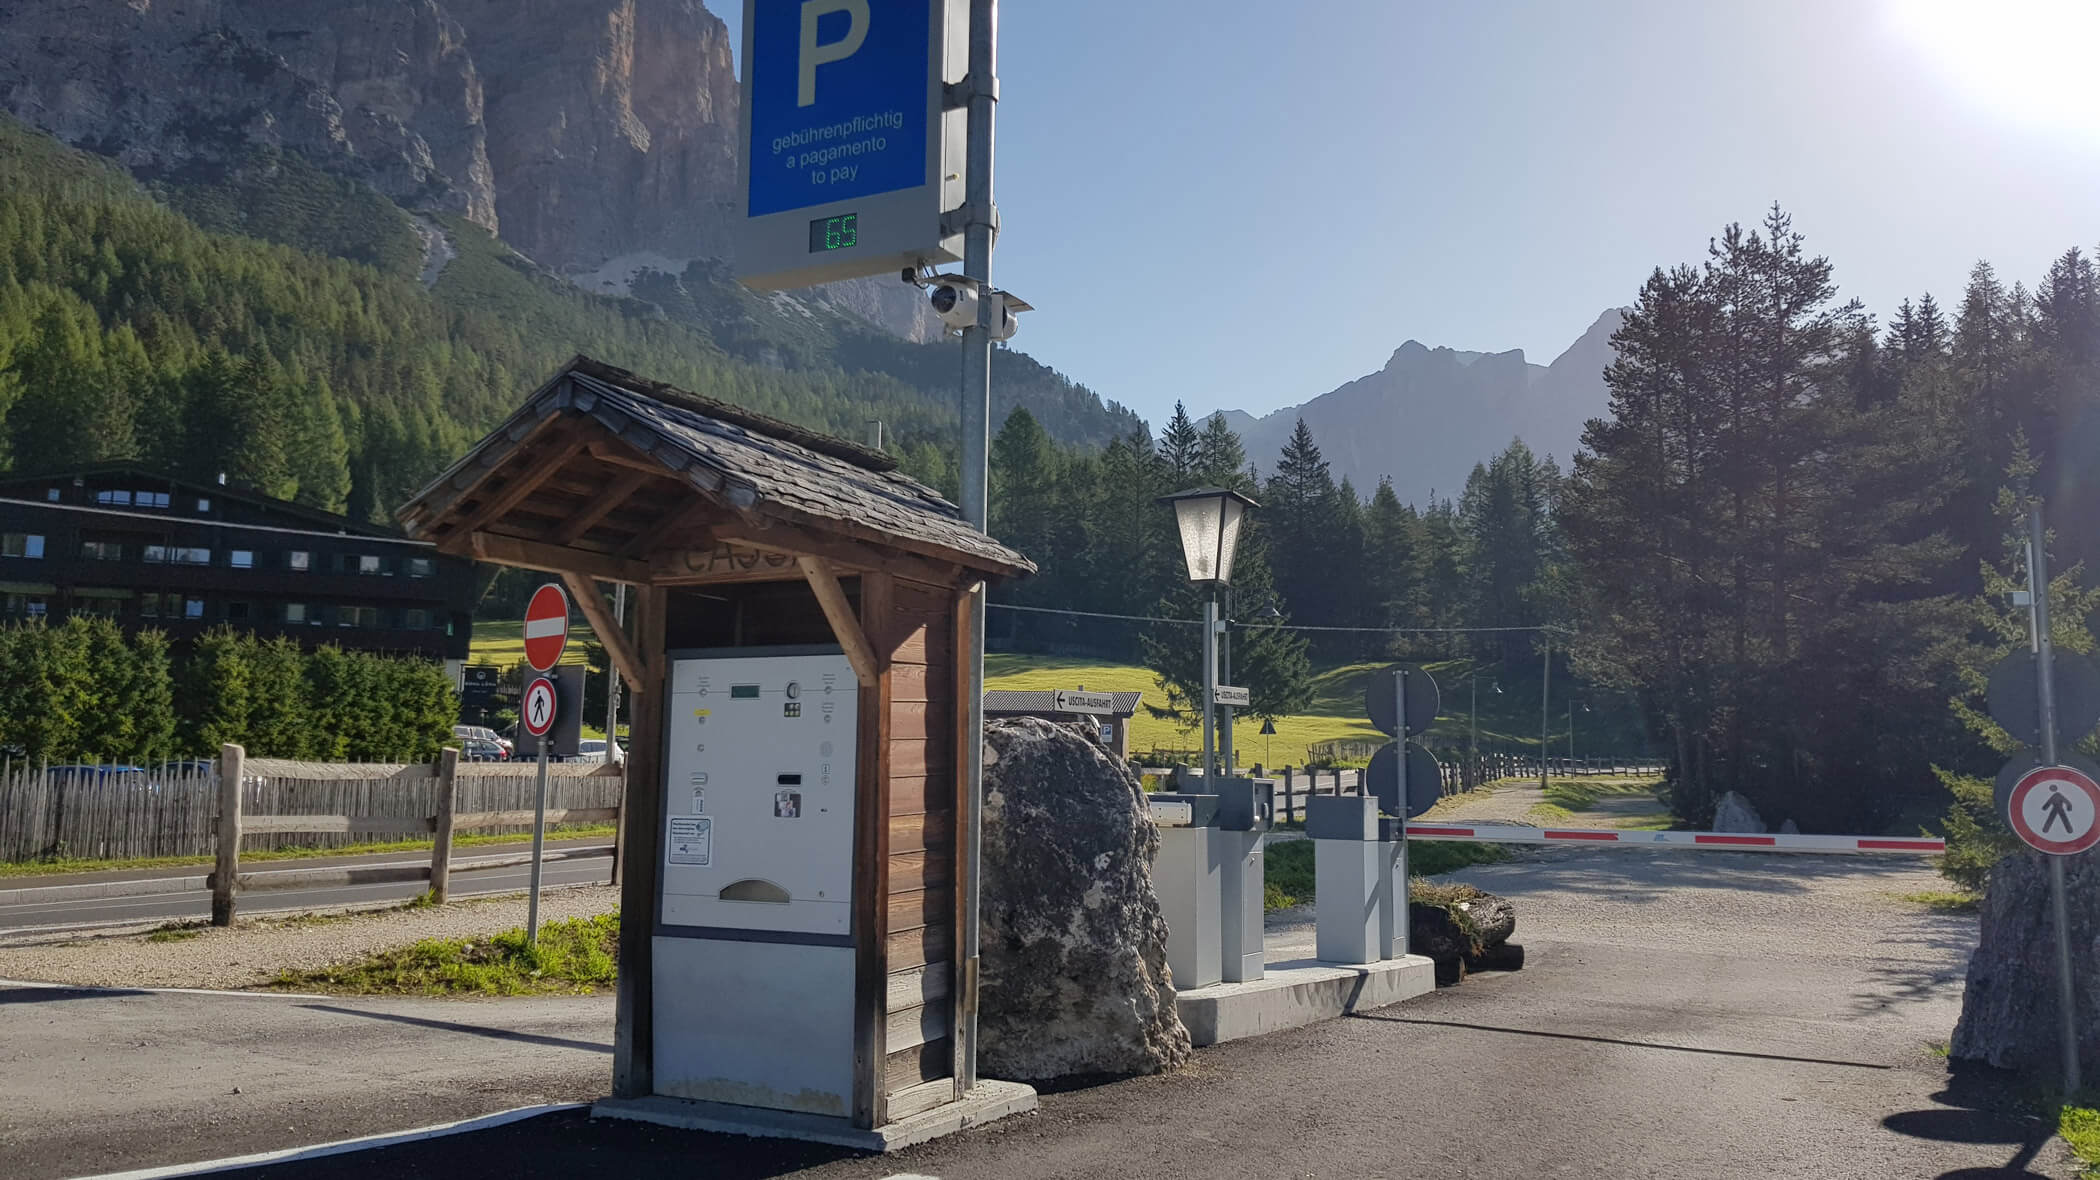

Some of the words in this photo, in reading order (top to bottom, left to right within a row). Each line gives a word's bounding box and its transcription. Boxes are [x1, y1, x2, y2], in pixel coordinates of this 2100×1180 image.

[797, 0, 871, 107] P
[772, 110, 903, 153] gebührenpflichtig
[786, 155, 796, 168] a
[800, 137, 887, 169] pagamento
[812, 170, 826, 184] to
[830, 164, 859, 185] pay
[1103, 726, 1111, 735] P
